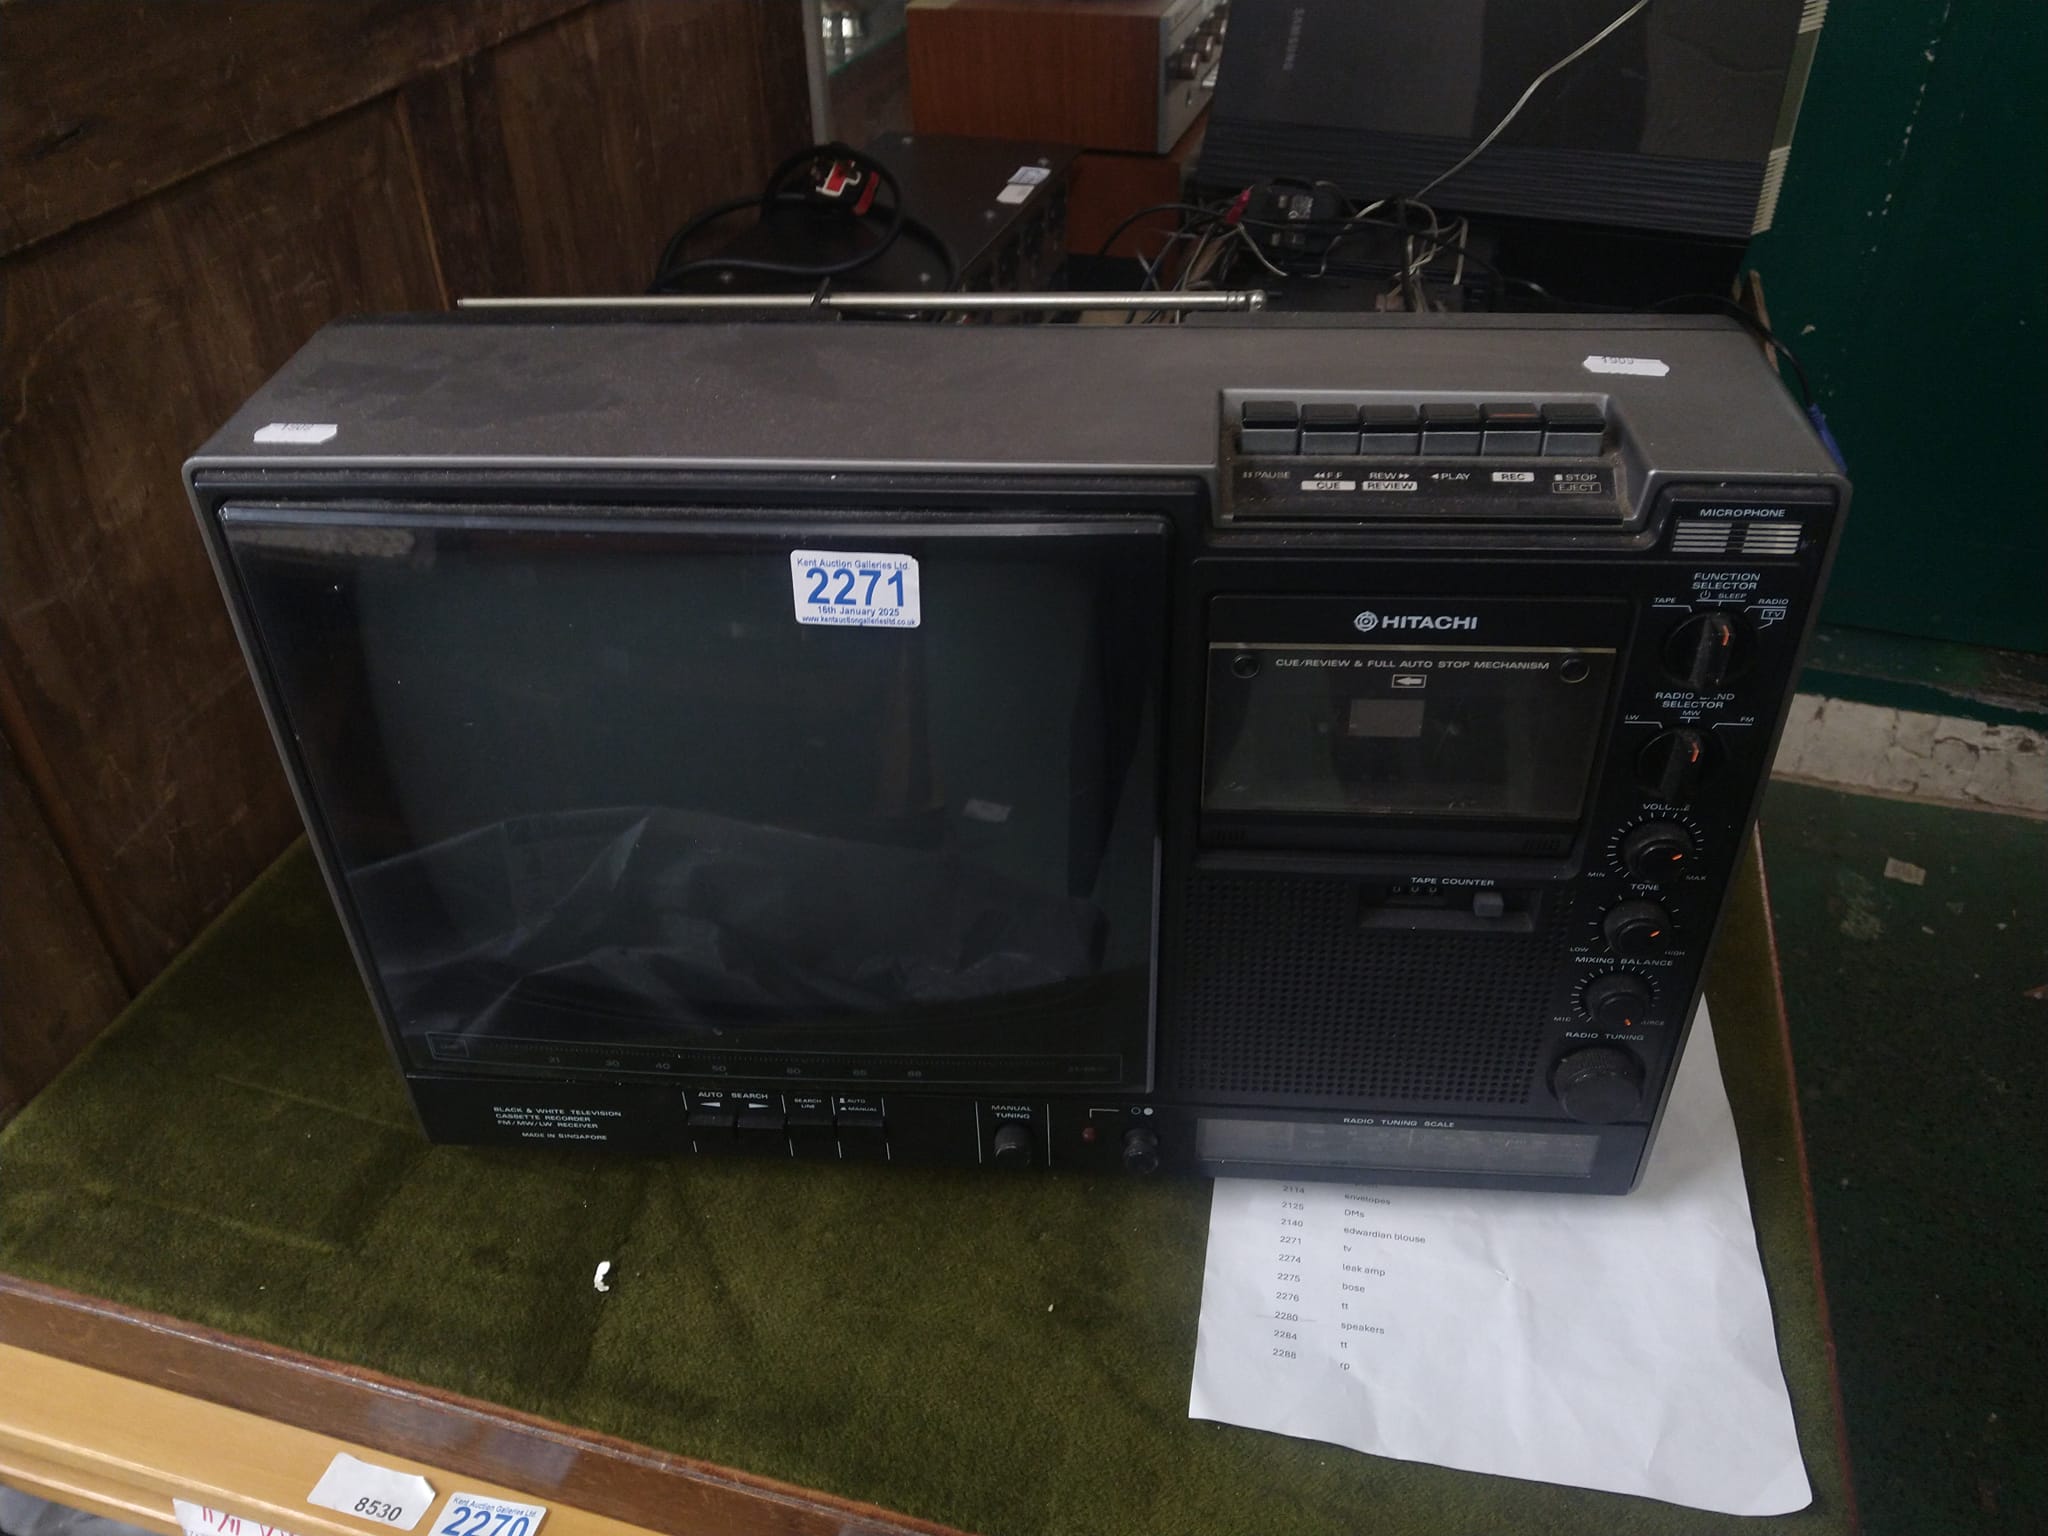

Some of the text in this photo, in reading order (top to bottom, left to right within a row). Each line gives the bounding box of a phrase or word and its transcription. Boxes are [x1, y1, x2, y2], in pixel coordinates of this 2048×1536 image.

[1369, 472, 1397, 480] REW
[1440, 472, 1471, 481] PLAY
[1501, 473, 1525, 481] REC
[1565, 473, 1597, 481] STOP
[1367, 482, 1414, 490] REVIEW
[1559, 484, 1595, 492] EJECT
[1700, 509, 1786, 518] MICROPHONE
[797, 558, 817, 567] Kent
[819, 559, 851, 568] Auction
[854, 560, 892, 570] Galleries
[1693, 573, 1761, 582] FUNCTION
[805, 567, 904, 607] 2271
[1692, 582, 1757, 590] SELECTOR
[839, 607, 876, 617] January
[878, 608, 900, 617] 2025
[1381, 615, 1478, 630] HITACHI
[1275, 658, 1550, 671] CUE/REVIEW & FULL AUTO STOP MECHANISM
[1655, 691, 1694, 700] RADIO
[1662, 700, 1724, 709] SELECTOR
[1442, 878, 1495, 886] COUNTER
[1631, 883, 1660, 891] TONE
[1575, 956, 1673, 967] MIXING BALANCE
[1565, 1031, 1645, 1041] RADIO TUNING
[731, 1092, 768, 1100] SEARCH
[570, 1109, 622, 1117] TELEVISION
[991, 1104, 1032, 1112] MANUAL
[995, 1112, 1030, 1120] TUNING
[1343, 1117, 1456, 1129] RADIO TUNING SCALE
[1344, 1193, 1391, 1206] envelopes
[1280, 1218, 1426, 1244] 2140 edwardian blouse
[1279, 1235, 1302, 1245] 2271
[1278, 1254, 1386, 1277] 2274 leak amp
[1276, 1272, 1366, 1293] 2275 bose
[1275, 1291, 1300, 1302] 2276
[1274, 1311, 1385, 1334] 2280 speakers
[1273, 1329, 1297, 1340] 2284
[1272, 1348, 1350, 1371] 2288 rp
[354, 1497, 403, 1522] 8530
[453, 1497, 468, 1507] Kent
[470, 1501, 495, 1512] Auction
[496, 1505, 524, 1516] Galleries
[440, 1506, 530, 1536] 2270
